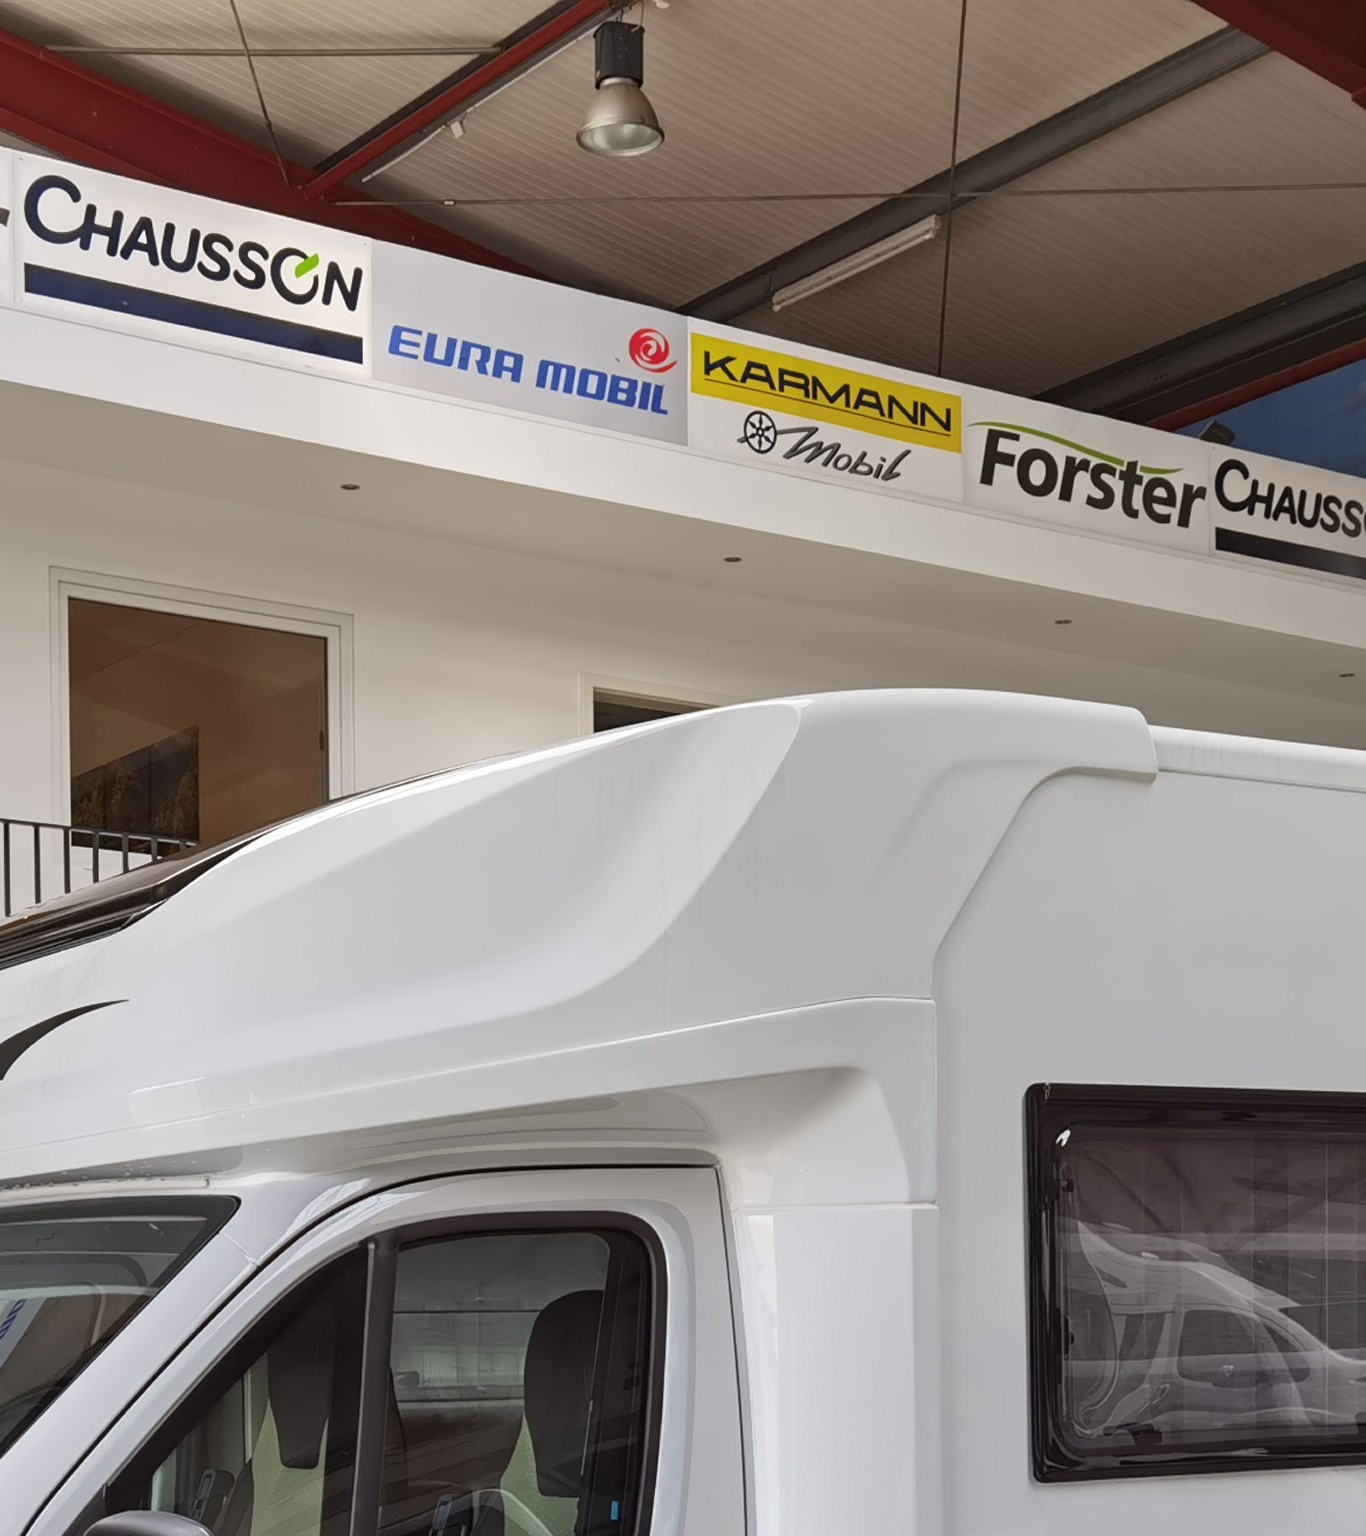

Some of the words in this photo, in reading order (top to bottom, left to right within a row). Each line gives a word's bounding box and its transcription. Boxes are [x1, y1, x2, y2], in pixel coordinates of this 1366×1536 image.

[24, 174, 363, 312] CHAUSSON
[388, 325, 523, 384] EURA
[535, 358, 669, 415] MOBIL
[703, 350, 952, 433] KARMANN
[777, 426, 912, 483] Mobil
[979, 427, 1207, 528] Forster
